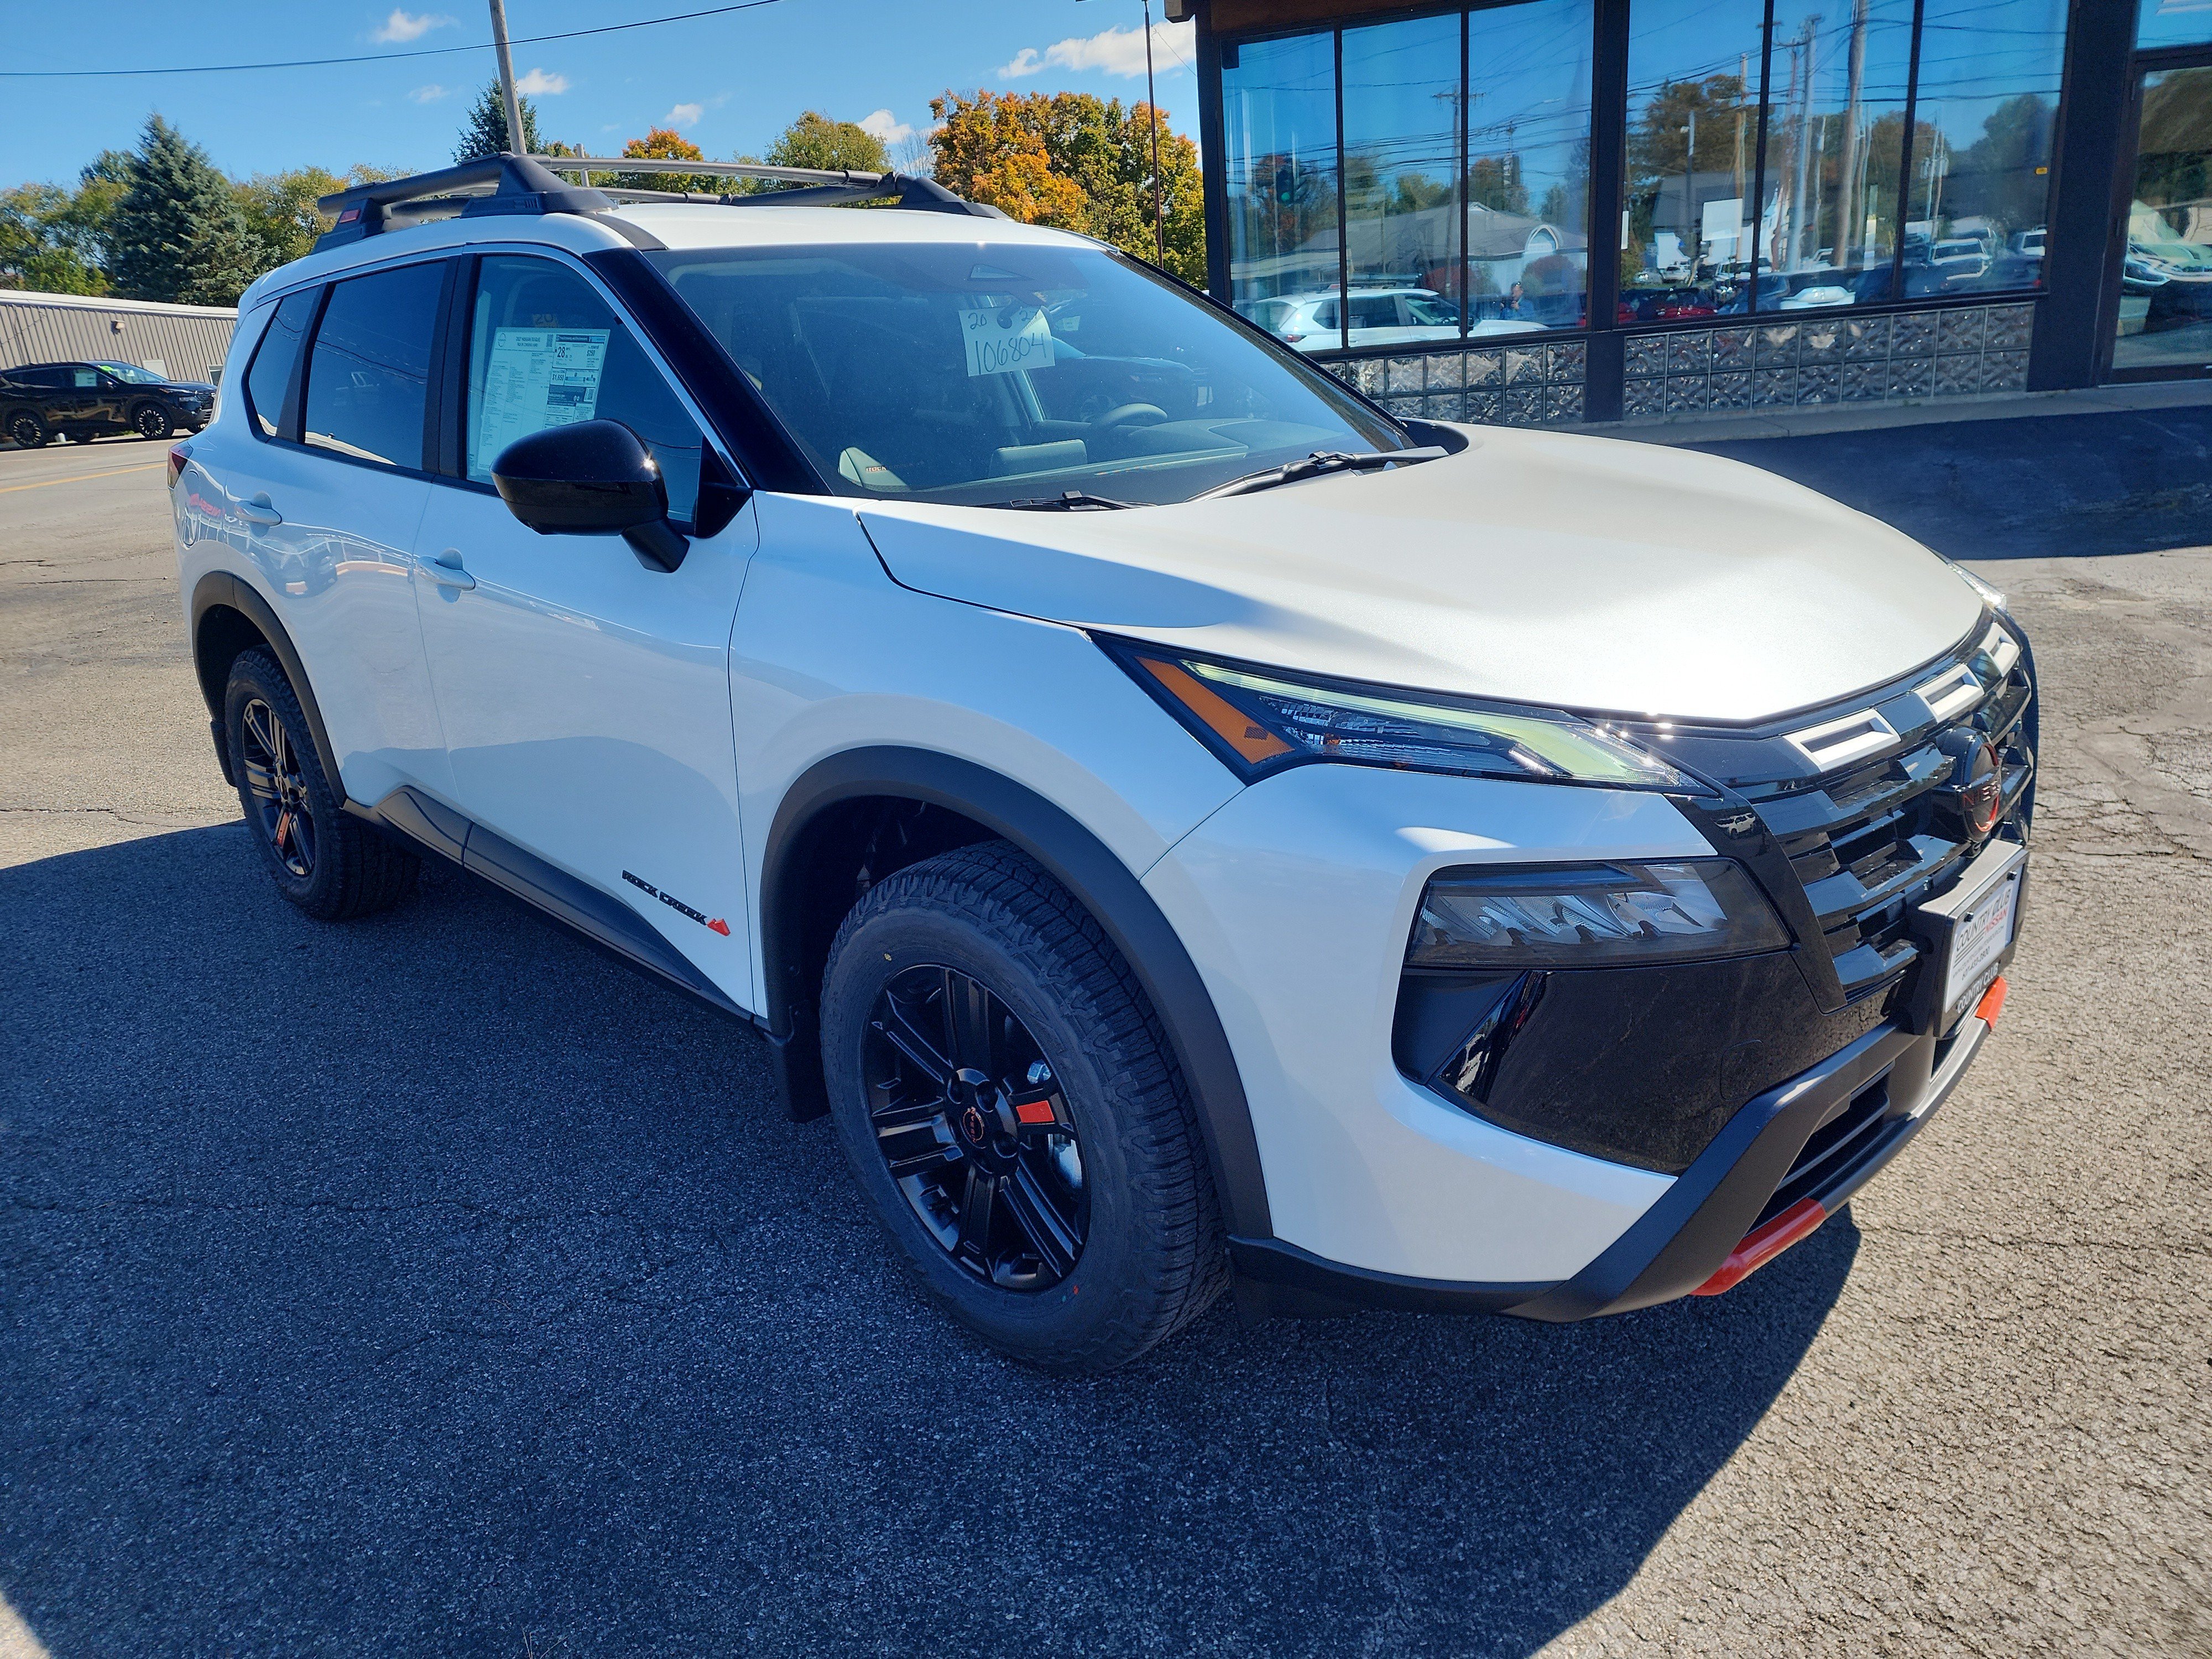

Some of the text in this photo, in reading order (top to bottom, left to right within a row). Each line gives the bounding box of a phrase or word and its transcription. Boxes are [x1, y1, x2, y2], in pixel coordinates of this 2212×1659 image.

[557, 347, 566, 358] 28
[975, 332, 1047, 375] 106804
[622, 870, 707, 926] ROCK CREEK
[1956, 888, 2011, 952] COUNTRY CLUB
[1984, 906, 2008, 935] NISSAN
[1958, 962, 1999, 1014] COUNTRY CLUB
